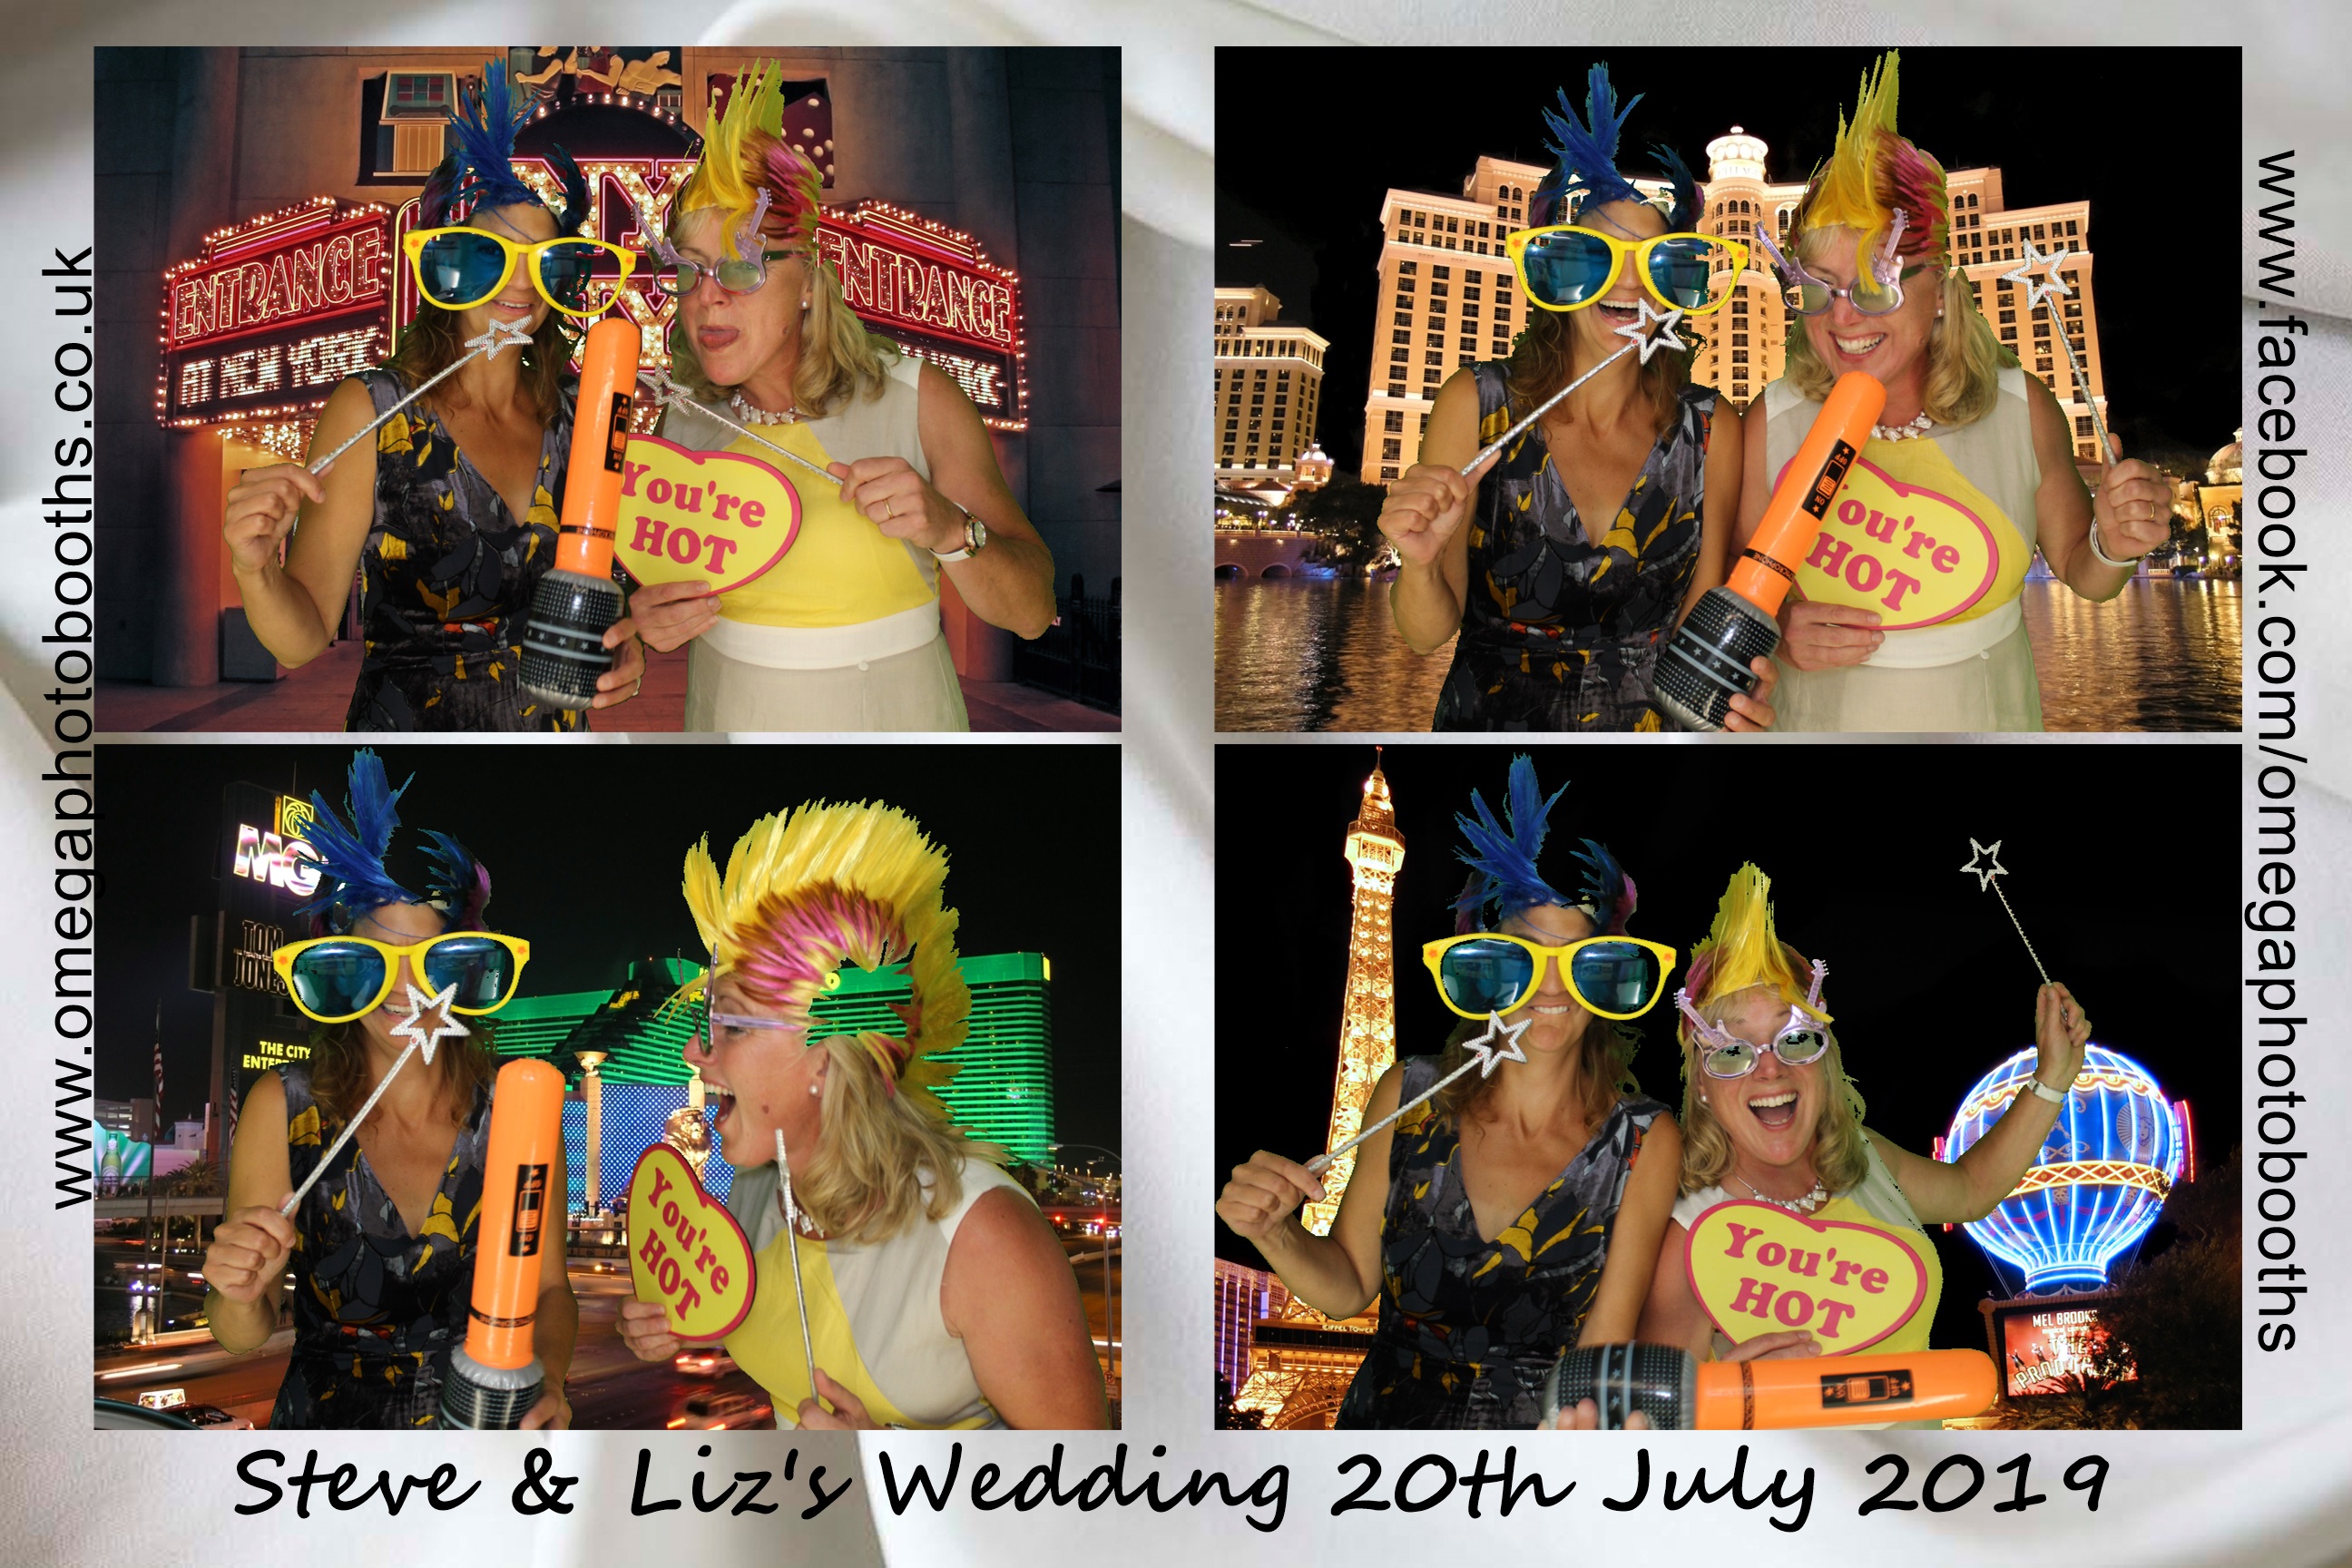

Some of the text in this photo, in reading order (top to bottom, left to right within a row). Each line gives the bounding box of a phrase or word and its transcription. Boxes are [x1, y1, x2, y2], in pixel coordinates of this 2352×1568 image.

[175, 227, 380, 339] ENTRANCE
[219, 344, 281, 399] NEW
[1834, 453, 1847, 466] OFF
[622, 461, 766, 528] You're
[1814, 495, 1826, 506] ON
[630, 516, 737, 574] HOT
[1838, 495, 1960, 573] ou're
[1806, 532, 1921, 612] HOT
[242, 919, 284, 958] TOM
[233, 953, 290, 996] JONES
[260, 1041, 311, 1060] THE CITY
[648, 1167, 730, 1295] You're
[1724, 1222, 1889, 1294] You're
[639, 1228, 701, 1321] HOT
[1322, 1324, 1375, 1334] EIFFEL TOWER
[1730, 1277, 1856, 1338] HOT
[2033, 1313, 2053, 1328] MEL
